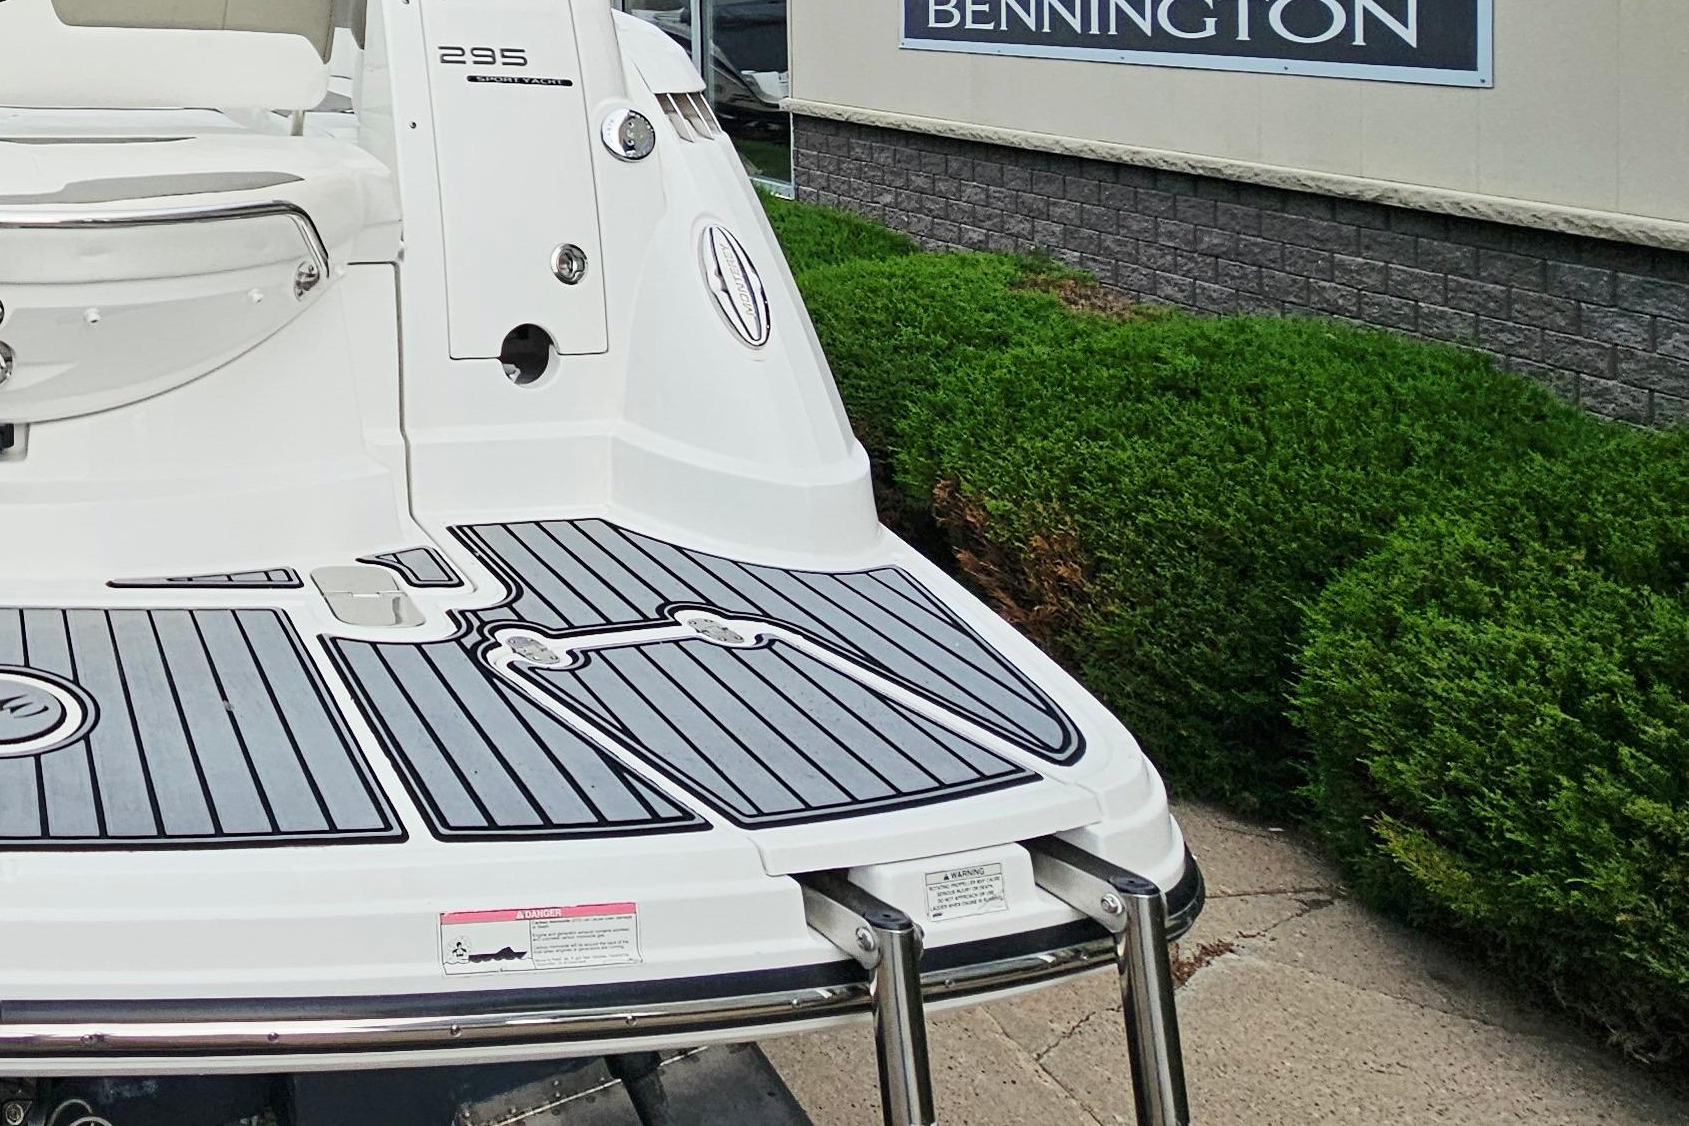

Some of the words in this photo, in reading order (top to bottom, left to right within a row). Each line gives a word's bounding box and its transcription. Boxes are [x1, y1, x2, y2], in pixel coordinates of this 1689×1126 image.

[438, 46, 528, 66] 295
[475, 75, 519, 83] SPORT
[522, 77, 563, 85] YACHT
[951, 867, 985, 879] WARNING
[525, 908, 562, 919] DANGER
